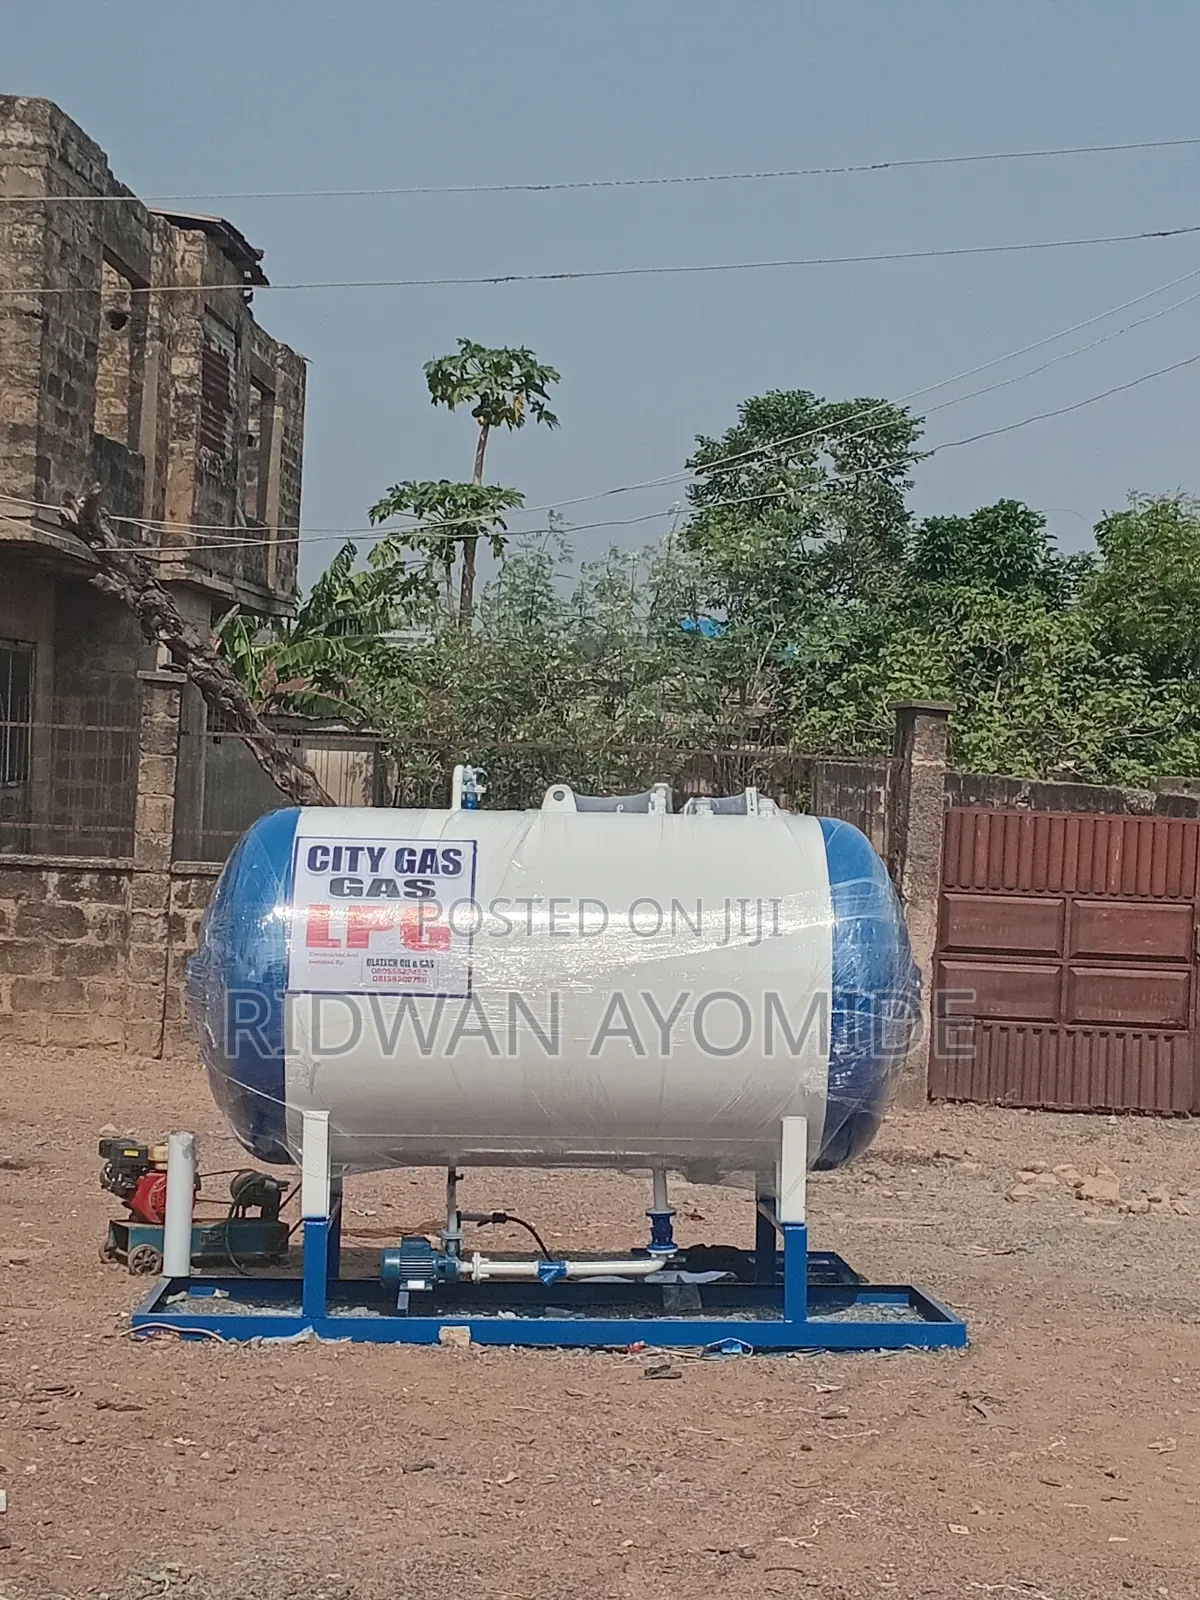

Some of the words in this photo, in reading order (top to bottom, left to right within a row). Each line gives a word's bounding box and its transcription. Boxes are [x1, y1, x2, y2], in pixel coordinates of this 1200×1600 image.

[308, 845, 386, 873] CITY
[395, 847, 462, 876] GAS
[329, 877, 436, 898] GAS
[305, 904, 451, 952] LPG
[419, 960, 435, 968] GAS
